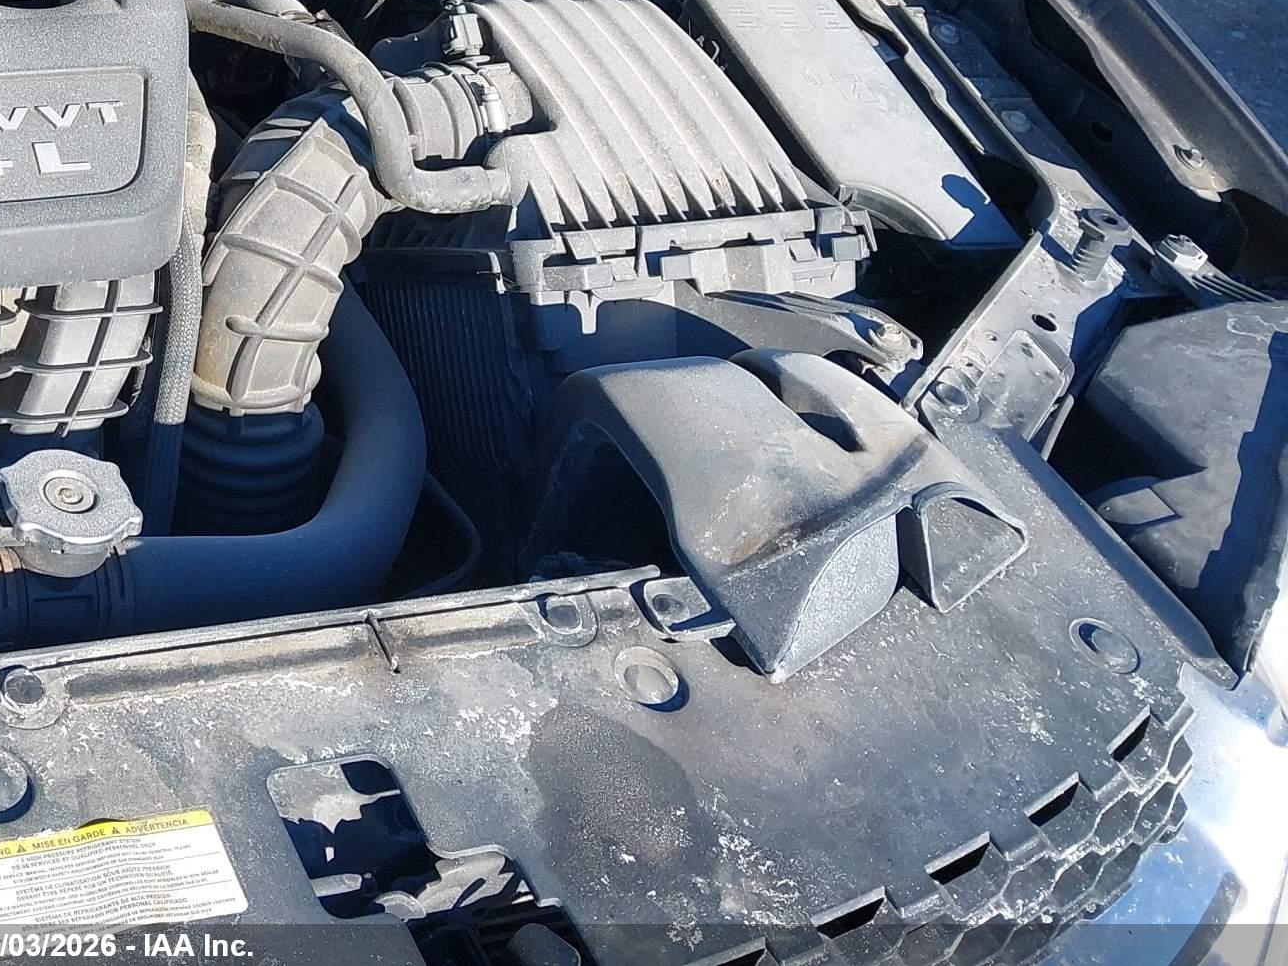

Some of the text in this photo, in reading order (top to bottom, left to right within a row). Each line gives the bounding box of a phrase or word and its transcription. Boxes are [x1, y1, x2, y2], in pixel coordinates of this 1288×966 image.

[32, 141, 92, 175] L
[32, 840, 57, 851] MISE
[58, 838, 71, 846] EN
[72, 829, 105, 843] GARDE
[125, 818, 189, 834] ADVERTENCIA
